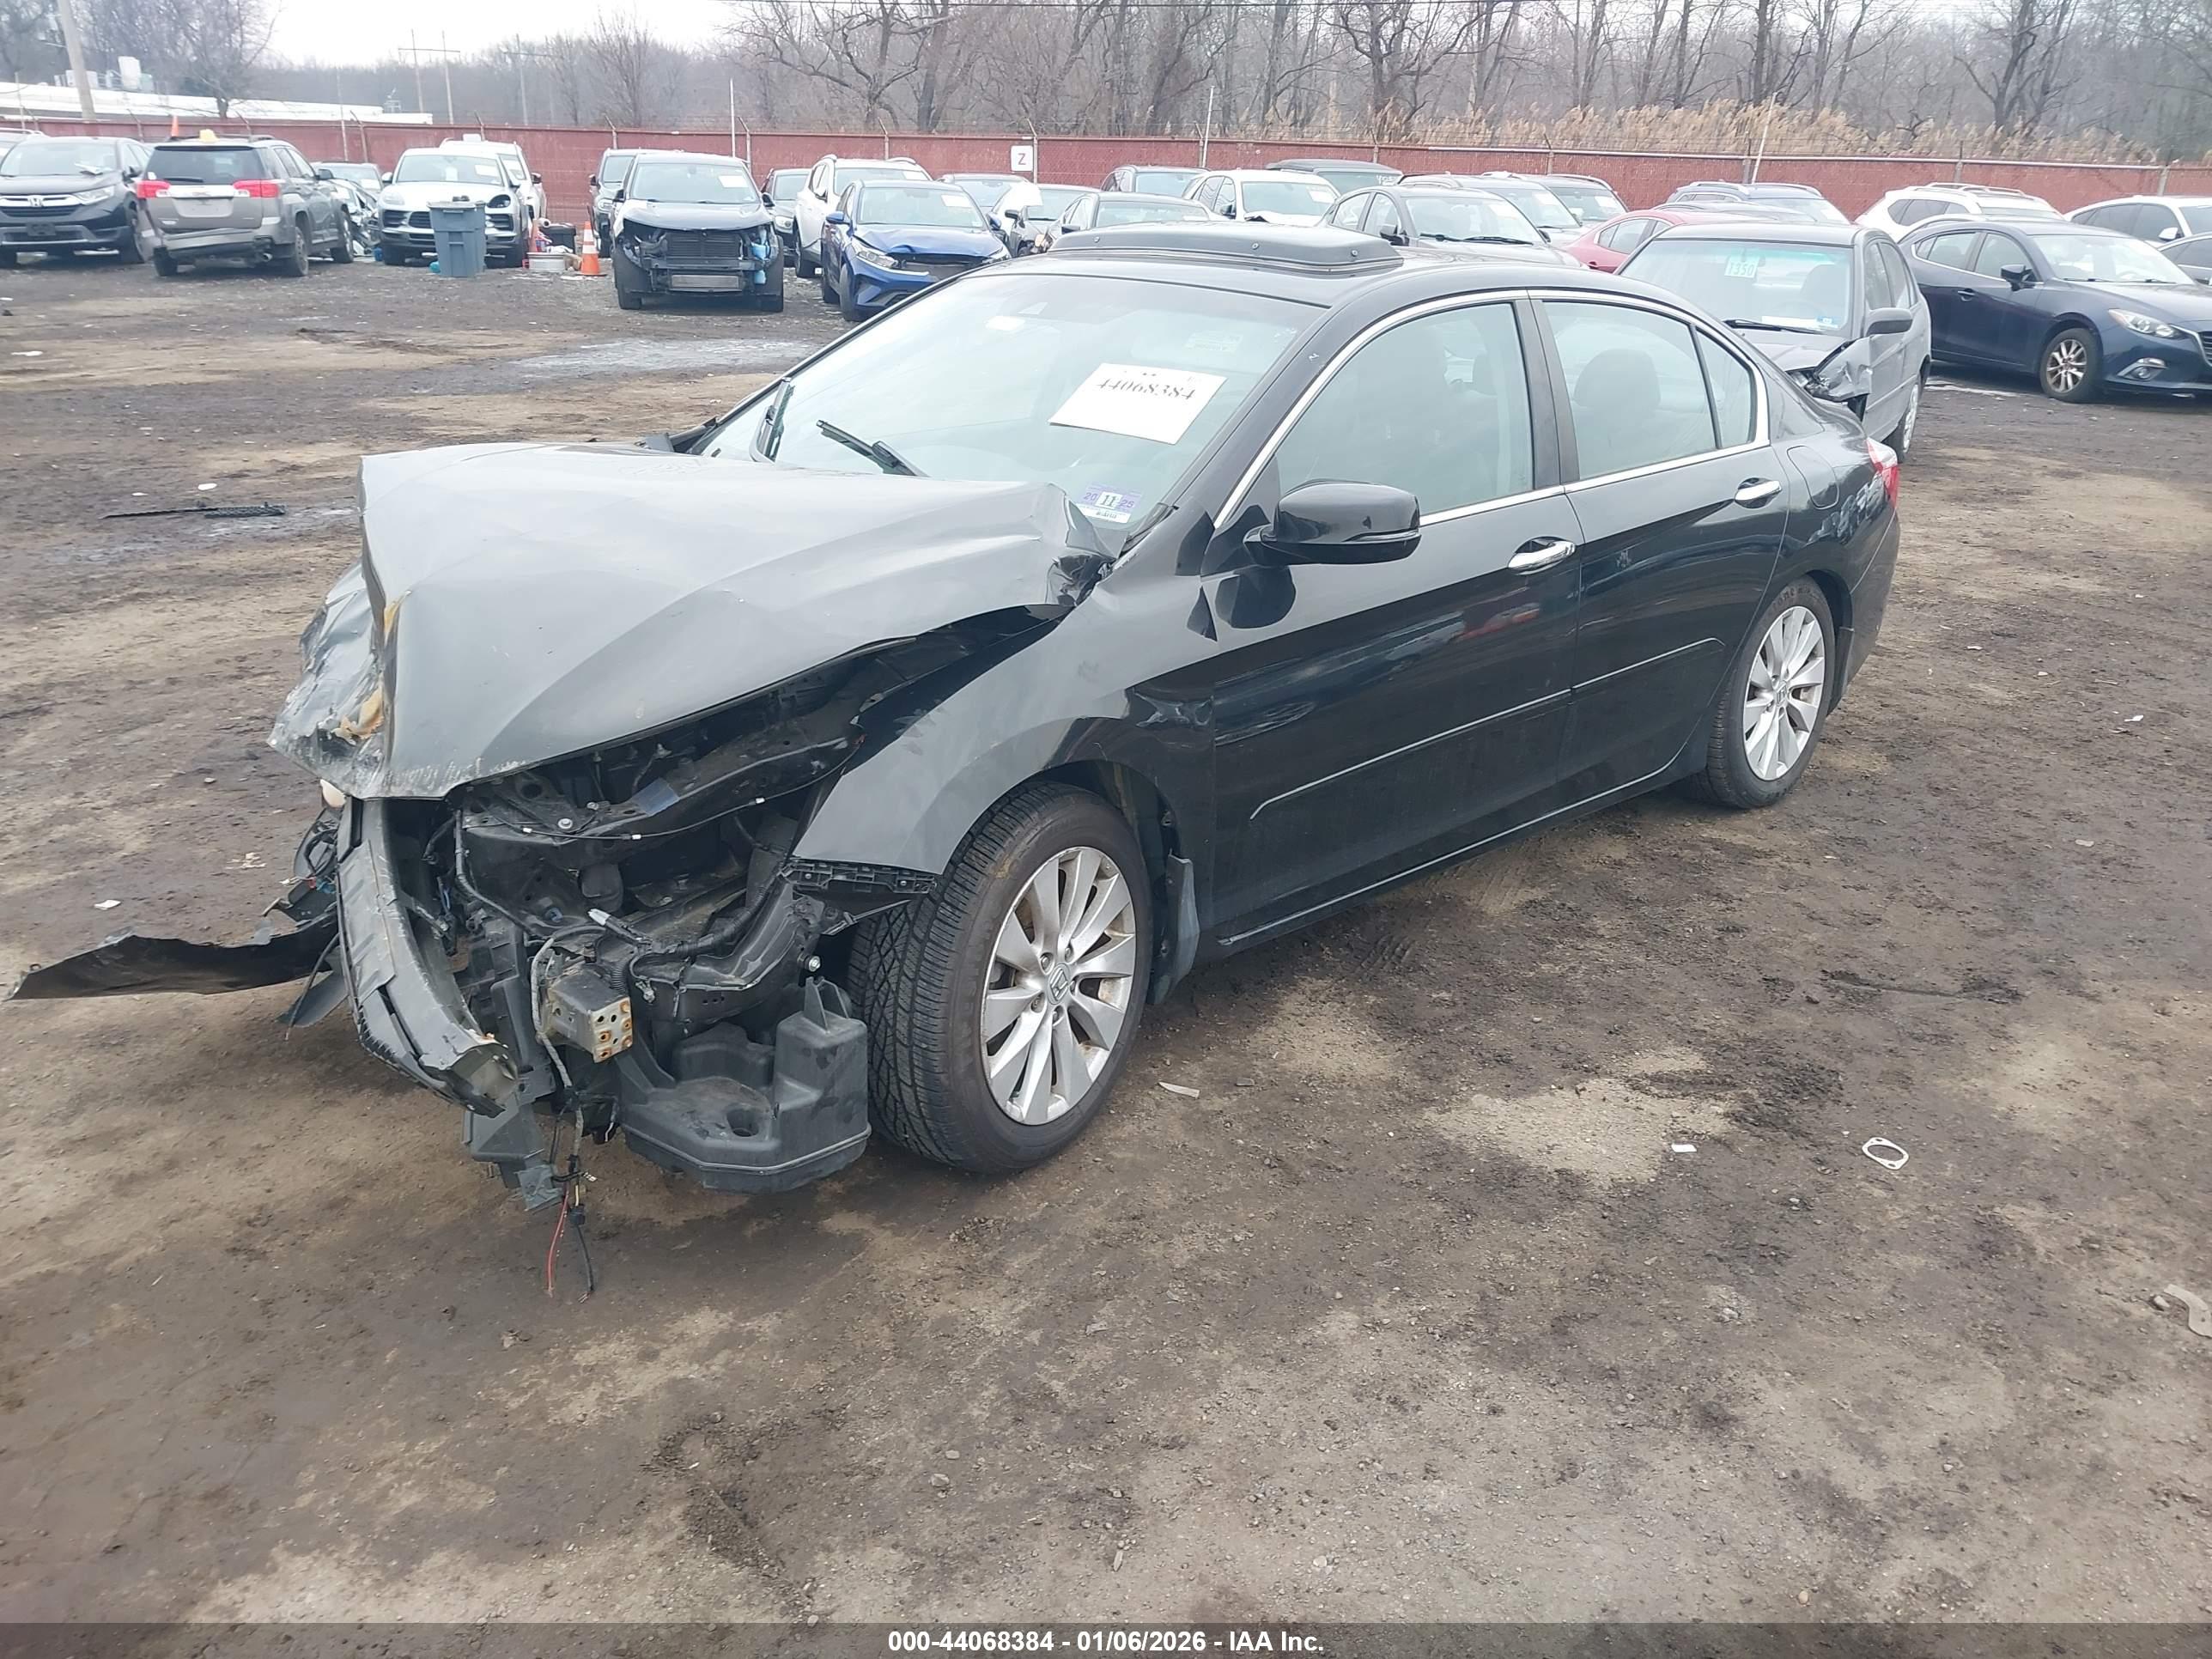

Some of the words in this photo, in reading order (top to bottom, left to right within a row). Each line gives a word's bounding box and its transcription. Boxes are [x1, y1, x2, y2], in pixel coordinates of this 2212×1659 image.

[1018, 153, 1026, 165] Z
[1097, 379, 1195, 399] 44068384
[1084, 492, 1098, 501] 20
[1100, 495, 1117, 507] 11
